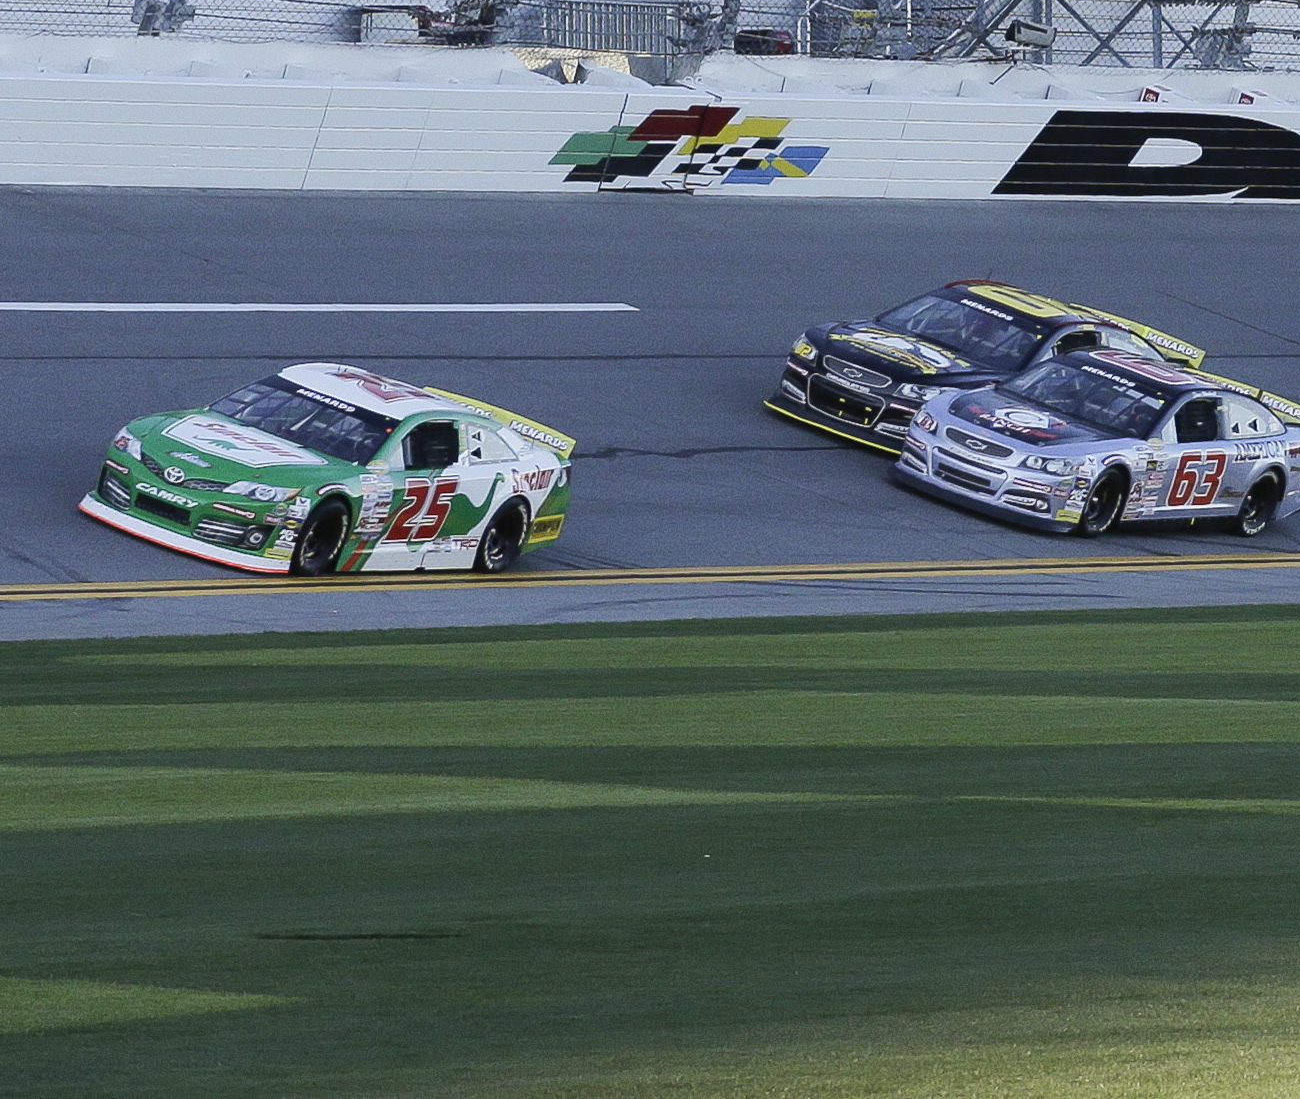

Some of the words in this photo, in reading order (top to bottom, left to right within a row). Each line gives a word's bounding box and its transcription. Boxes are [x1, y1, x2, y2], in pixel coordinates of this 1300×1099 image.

[960, 298, 1014, 321] MENARDS
[1147, 331, 1200, 359] MENARDS
[1081, 364, 1136, 388] MENARDS
[297, 387, 356, 413] MENARDS
[193, 421, 304, 459] Sinclair
[510, 419, 569, 452] MENARDS
[511, 464, 554, 494] Sinclair
[1167, 449, 1228, 507] 63
[135, 482, 200, 509] CAMRY
[380, 475, 459, 544] 25
